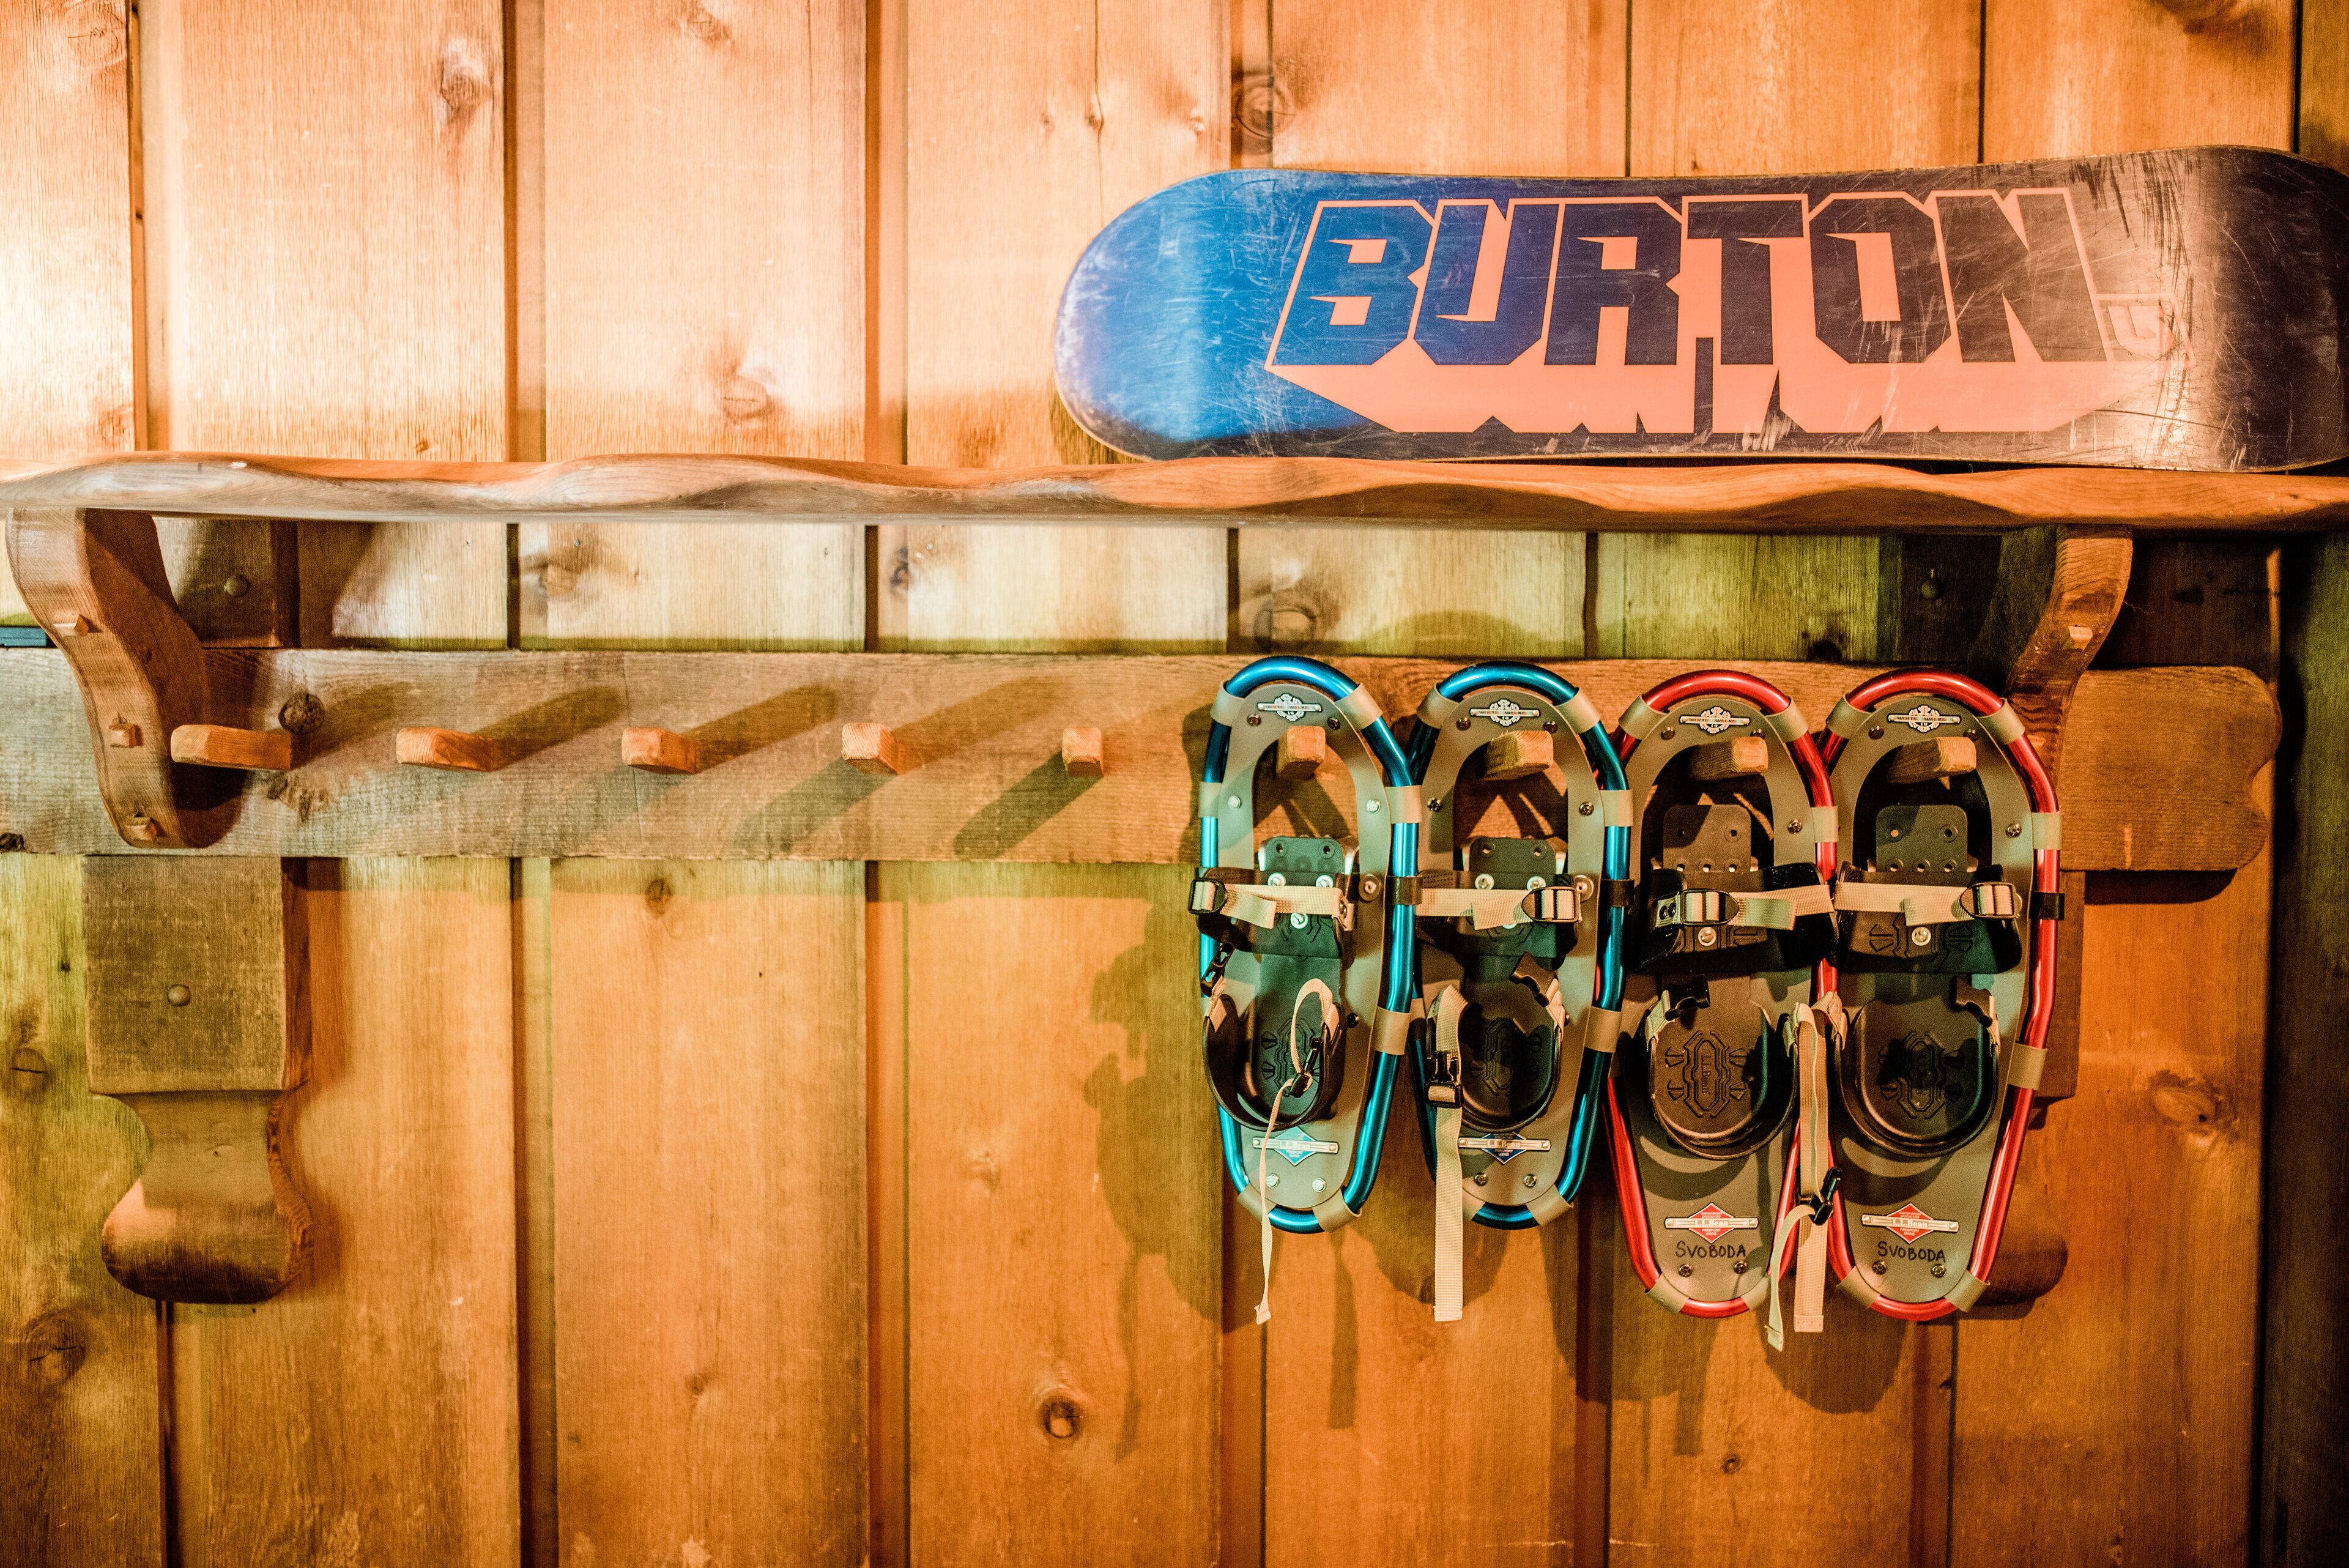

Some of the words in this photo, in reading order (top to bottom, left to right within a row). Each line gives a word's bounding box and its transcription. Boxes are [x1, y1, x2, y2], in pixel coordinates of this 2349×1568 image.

[1265, 187, 2110, 367] BURTON
[1487, 1140, 1521, 1148] L.L.Bean
[1893, 1219, 1928, 1228] L.L.Bean
[1675, 1240, 1746, 1258] SVOBODA
[1877, 1241, 1946, 1263] SVOBODA
